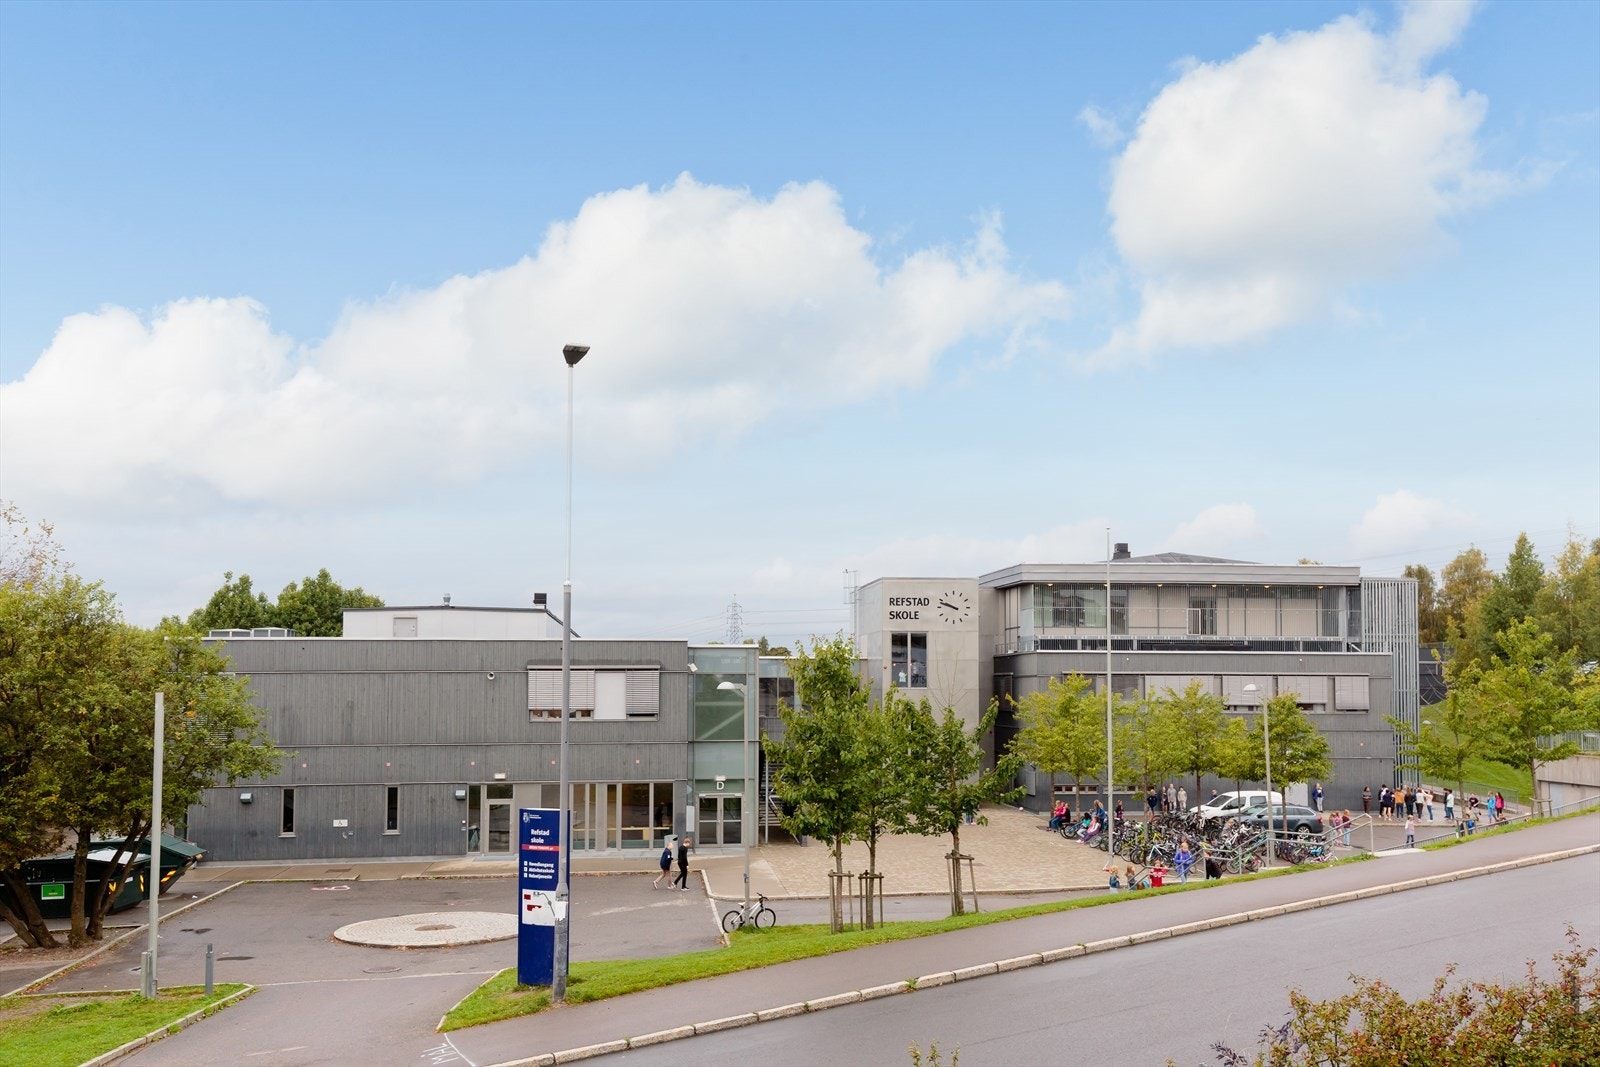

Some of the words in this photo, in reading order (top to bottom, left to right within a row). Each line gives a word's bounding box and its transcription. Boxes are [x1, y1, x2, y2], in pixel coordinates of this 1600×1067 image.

[889, 598, 930, 606] REFSTAD
[889, 611, 919, 620] SKOLE
[716, 782, 724, 790] D
